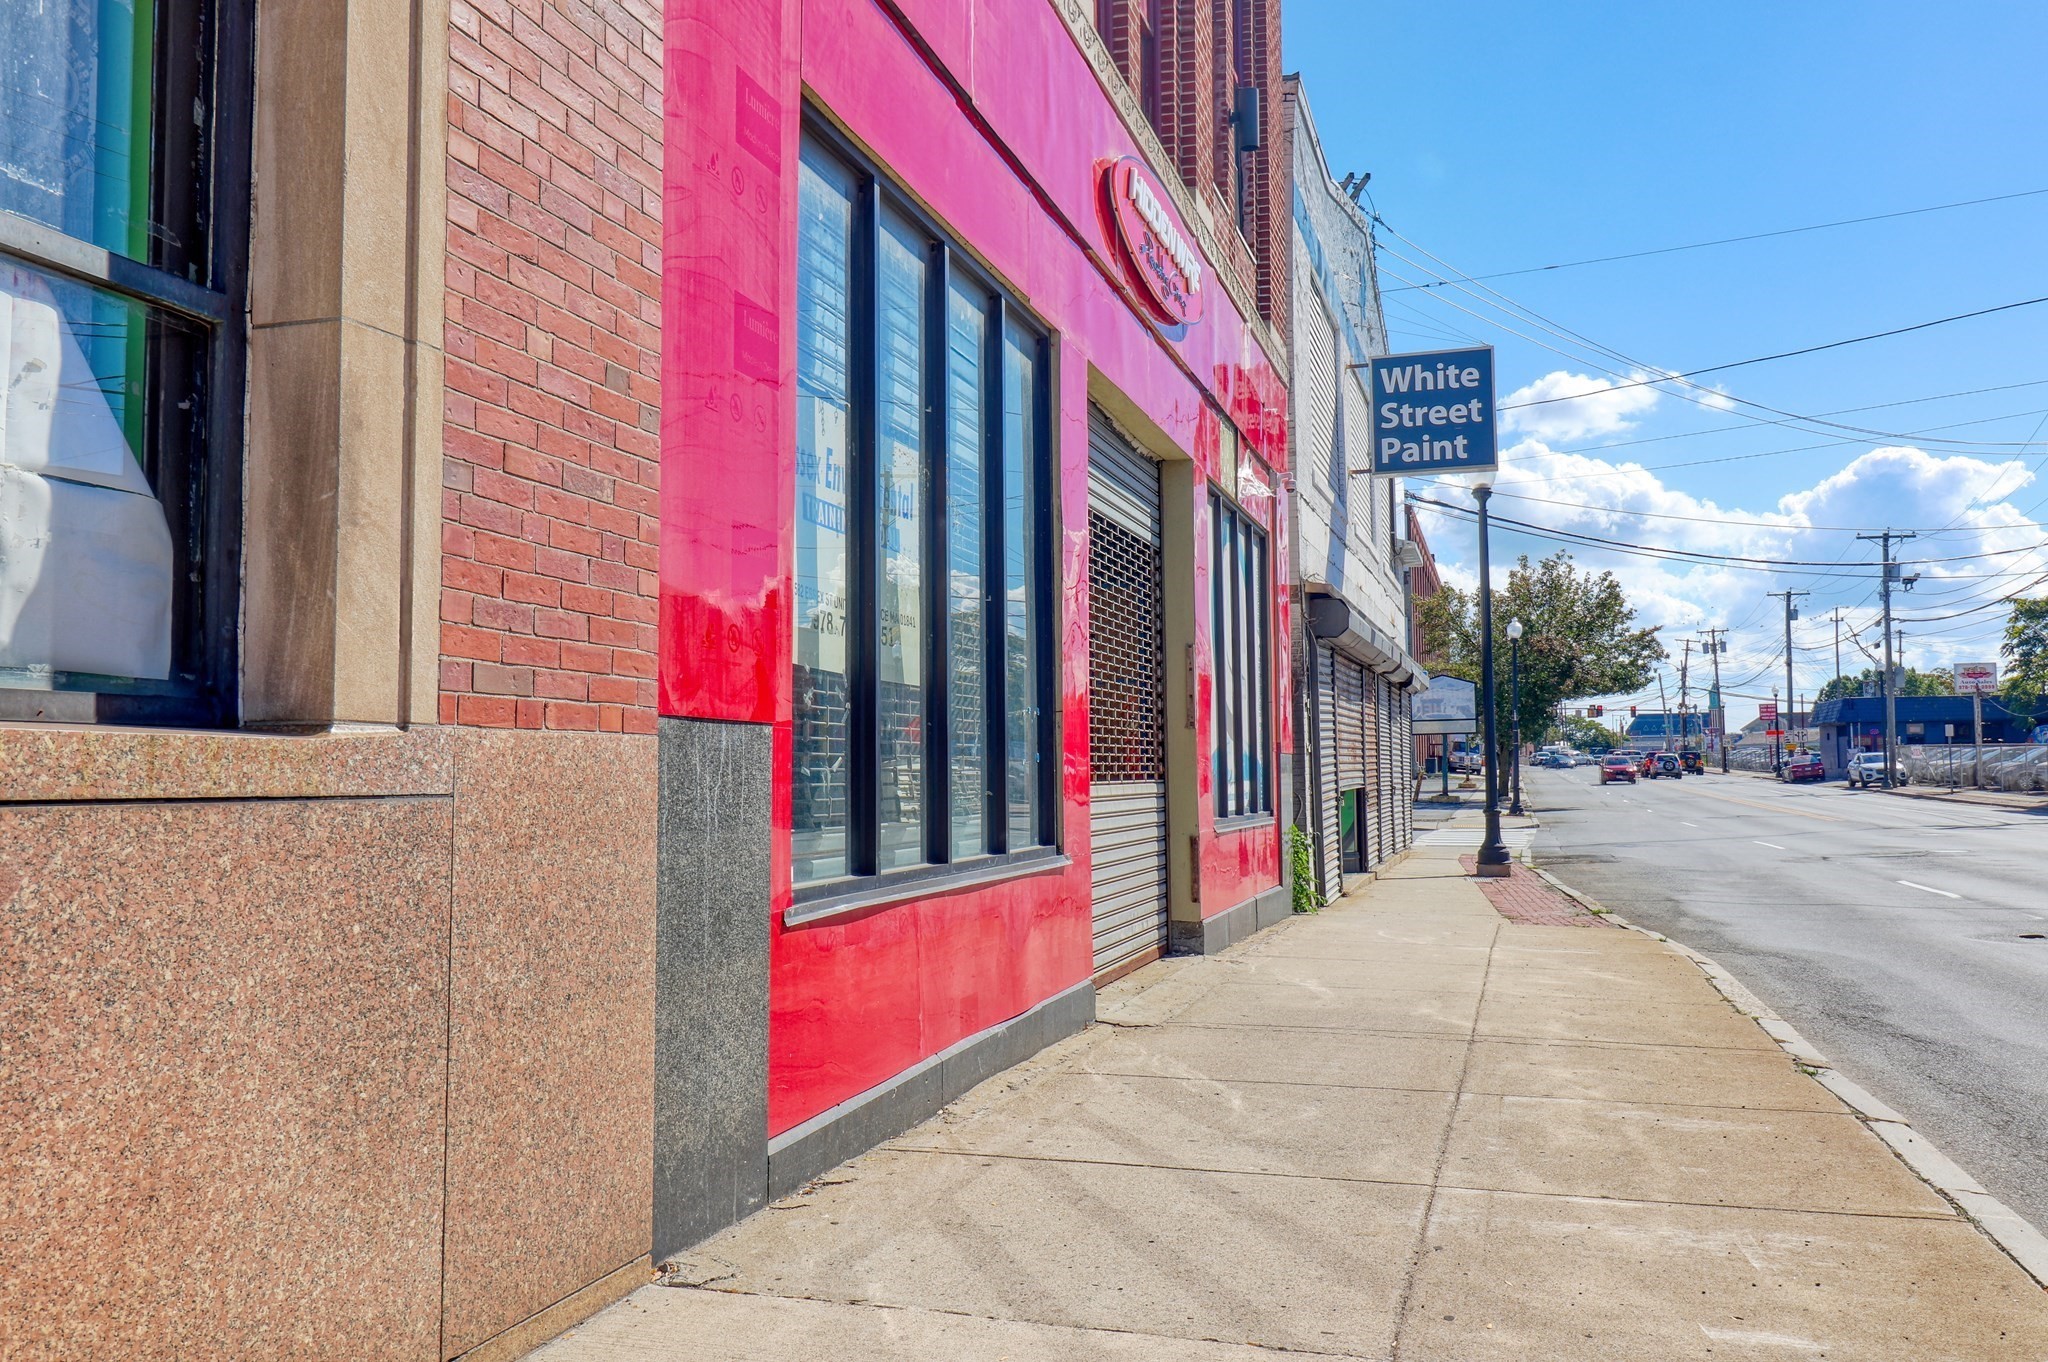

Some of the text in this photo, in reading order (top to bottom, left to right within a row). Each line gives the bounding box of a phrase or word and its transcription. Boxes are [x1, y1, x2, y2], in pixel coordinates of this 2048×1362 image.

[1379, 362, 1480, 394] White
[1380, 398, 1483, 429] Street
[1381, 434, 1468, 464] Paint
